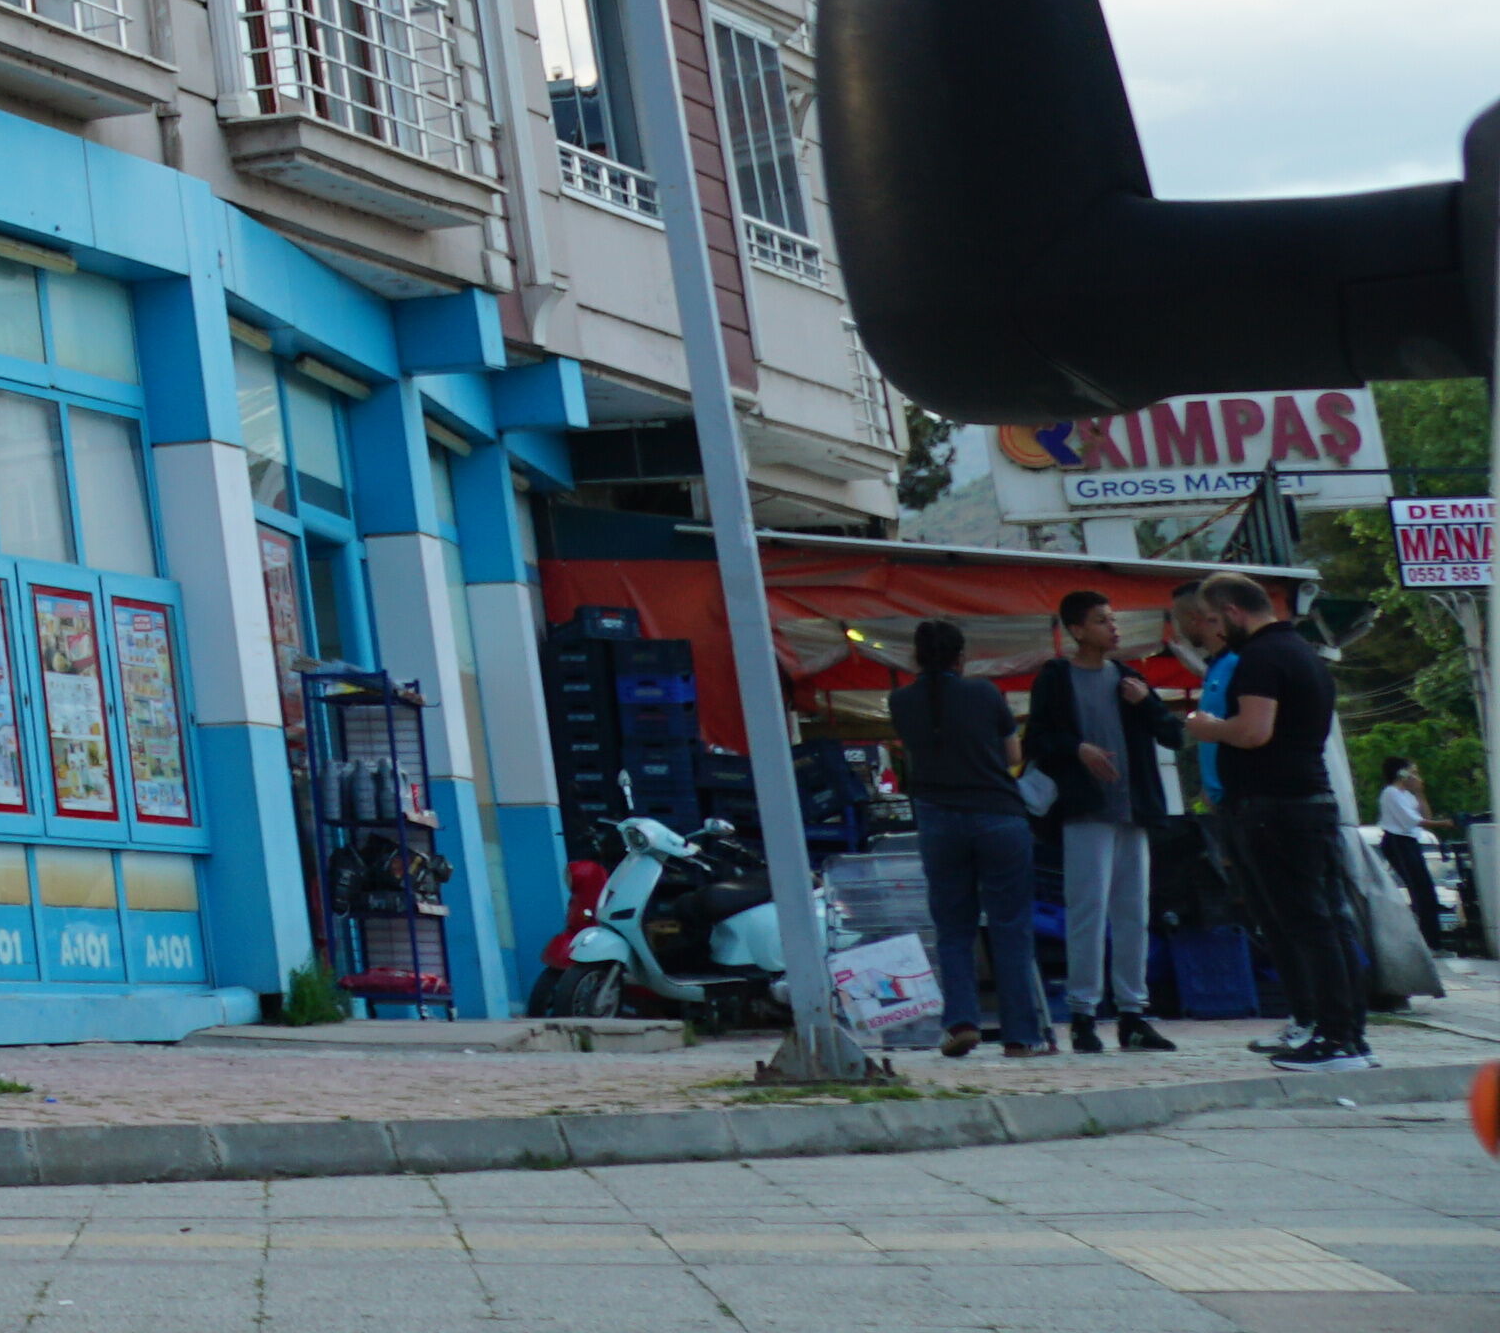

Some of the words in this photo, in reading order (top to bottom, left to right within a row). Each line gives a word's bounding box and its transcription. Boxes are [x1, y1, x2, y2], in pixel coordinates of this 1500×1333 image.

[1077, 476, 1176, 499] GROSS
[1184, 473, 1306, 493] MARET
[1408, 568, 1446, 582] 0552
[1451, 566, 1481, 581] 585
